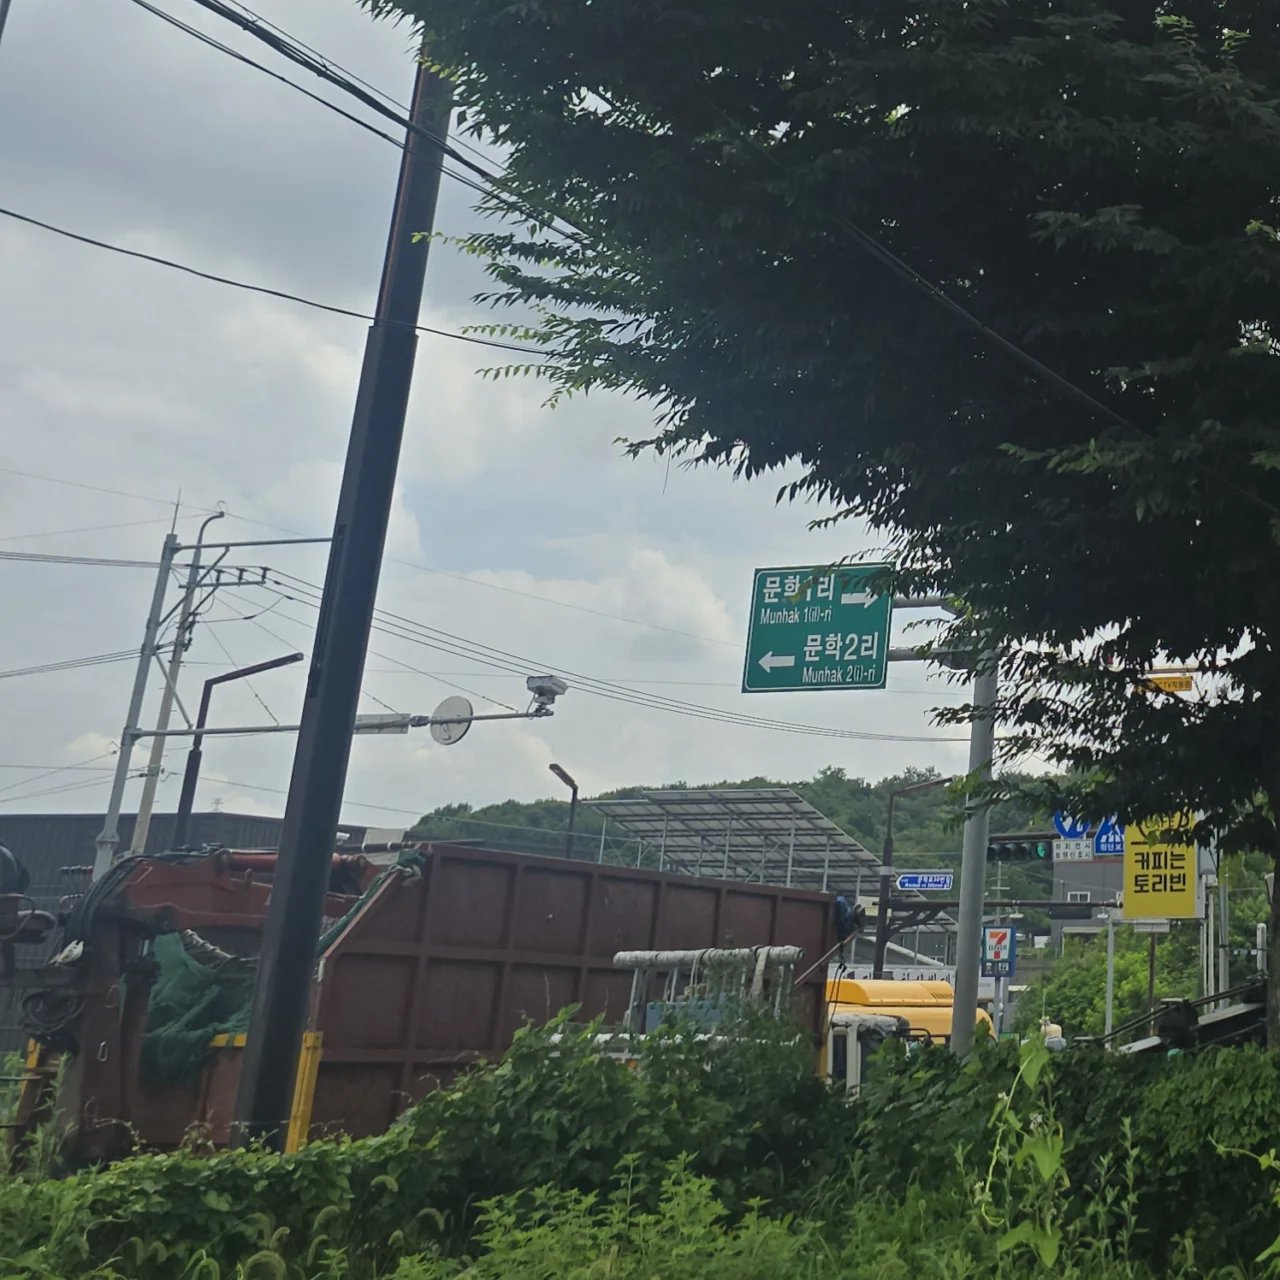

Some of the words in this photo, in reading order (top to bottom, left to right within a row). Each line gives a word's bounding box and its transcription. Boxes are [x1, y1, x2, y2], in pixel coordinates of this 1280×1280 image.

[763, 574, 835, 603] 문학1리
[760, 606, 800, 624] Munhak
[804, 605, 832, 622] 1(il)-ri
[803, 631, 879, 662] 문학2리
[802, 664, 843, 683] Munhak
[846, 663, 876, 682] 2(i)-ri
[1100, 842, 1124, 851] 횡단보
[1134, 851, 1186, 870] 커피는
[1134, 873, 1186, 893] 토리빈
